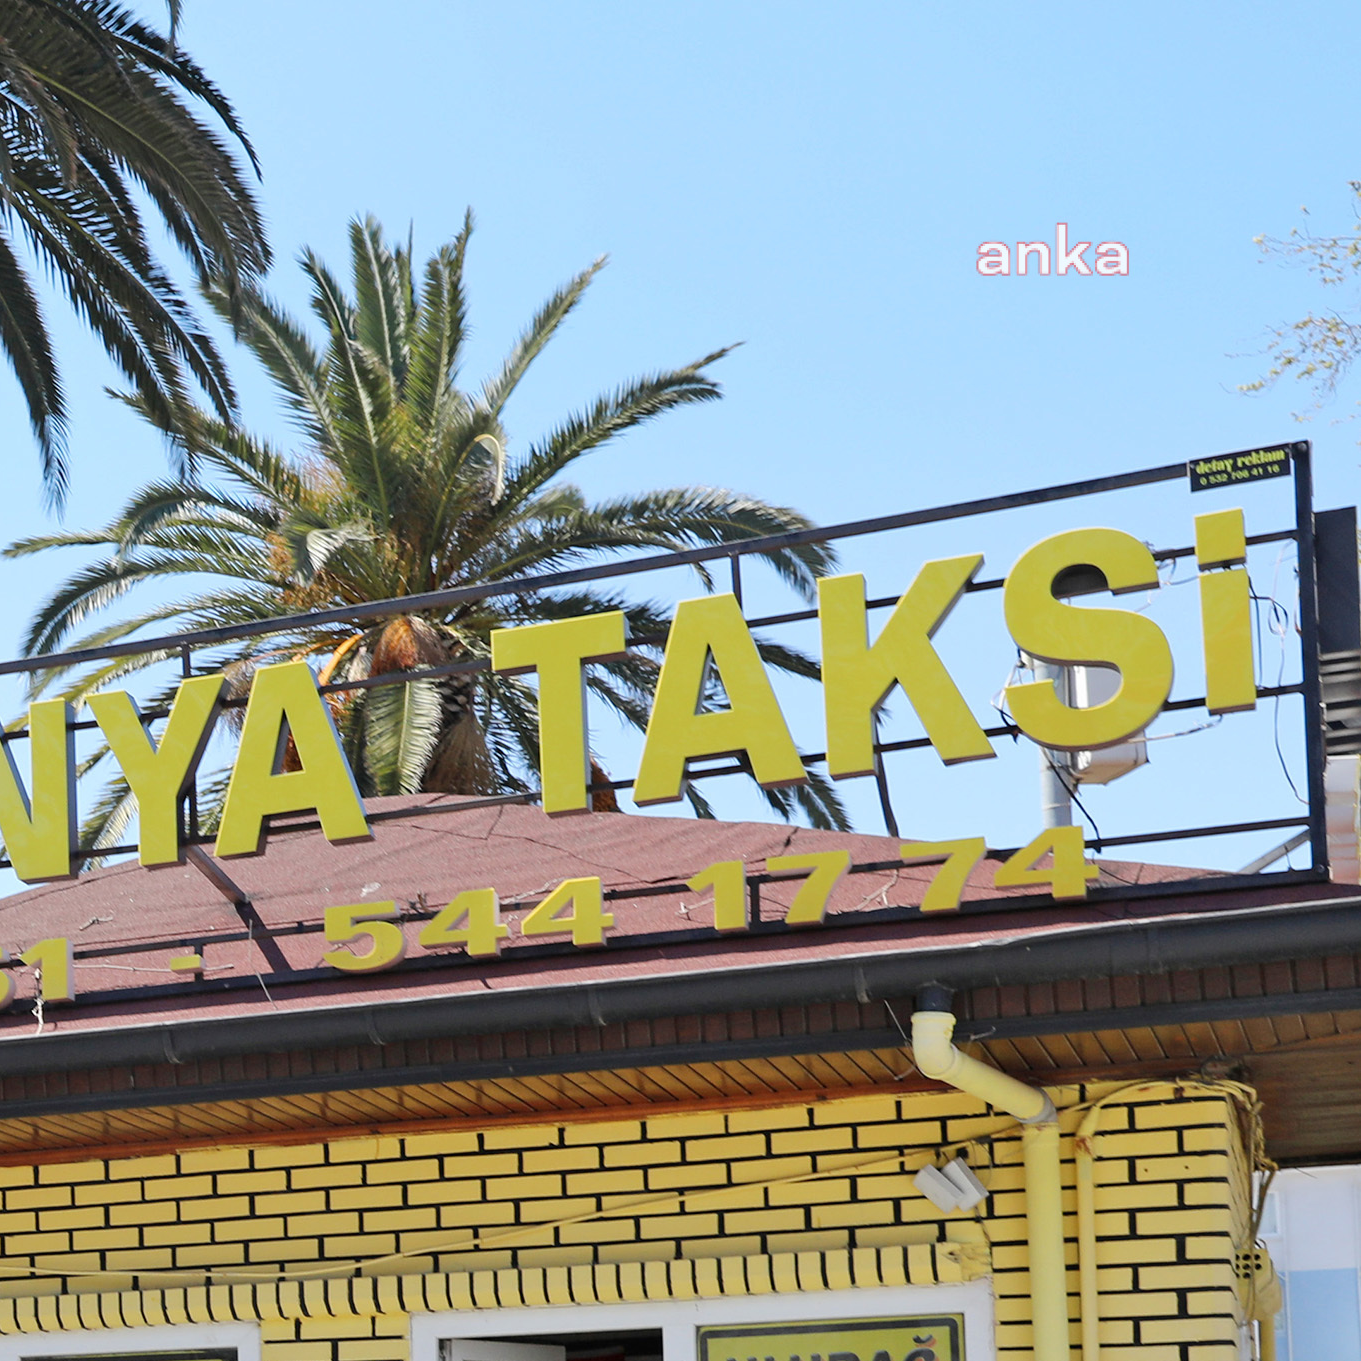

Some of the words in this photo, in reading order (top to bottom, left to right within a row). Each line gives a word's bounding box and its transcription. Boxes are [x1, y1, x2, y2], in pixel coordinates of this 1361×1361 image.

[1236, 449, 1286, 468] reklam
[322, 875, 617, 975] 544
[685, 848, 854, 935] 17
[899, 824, 1100, 915] 74
